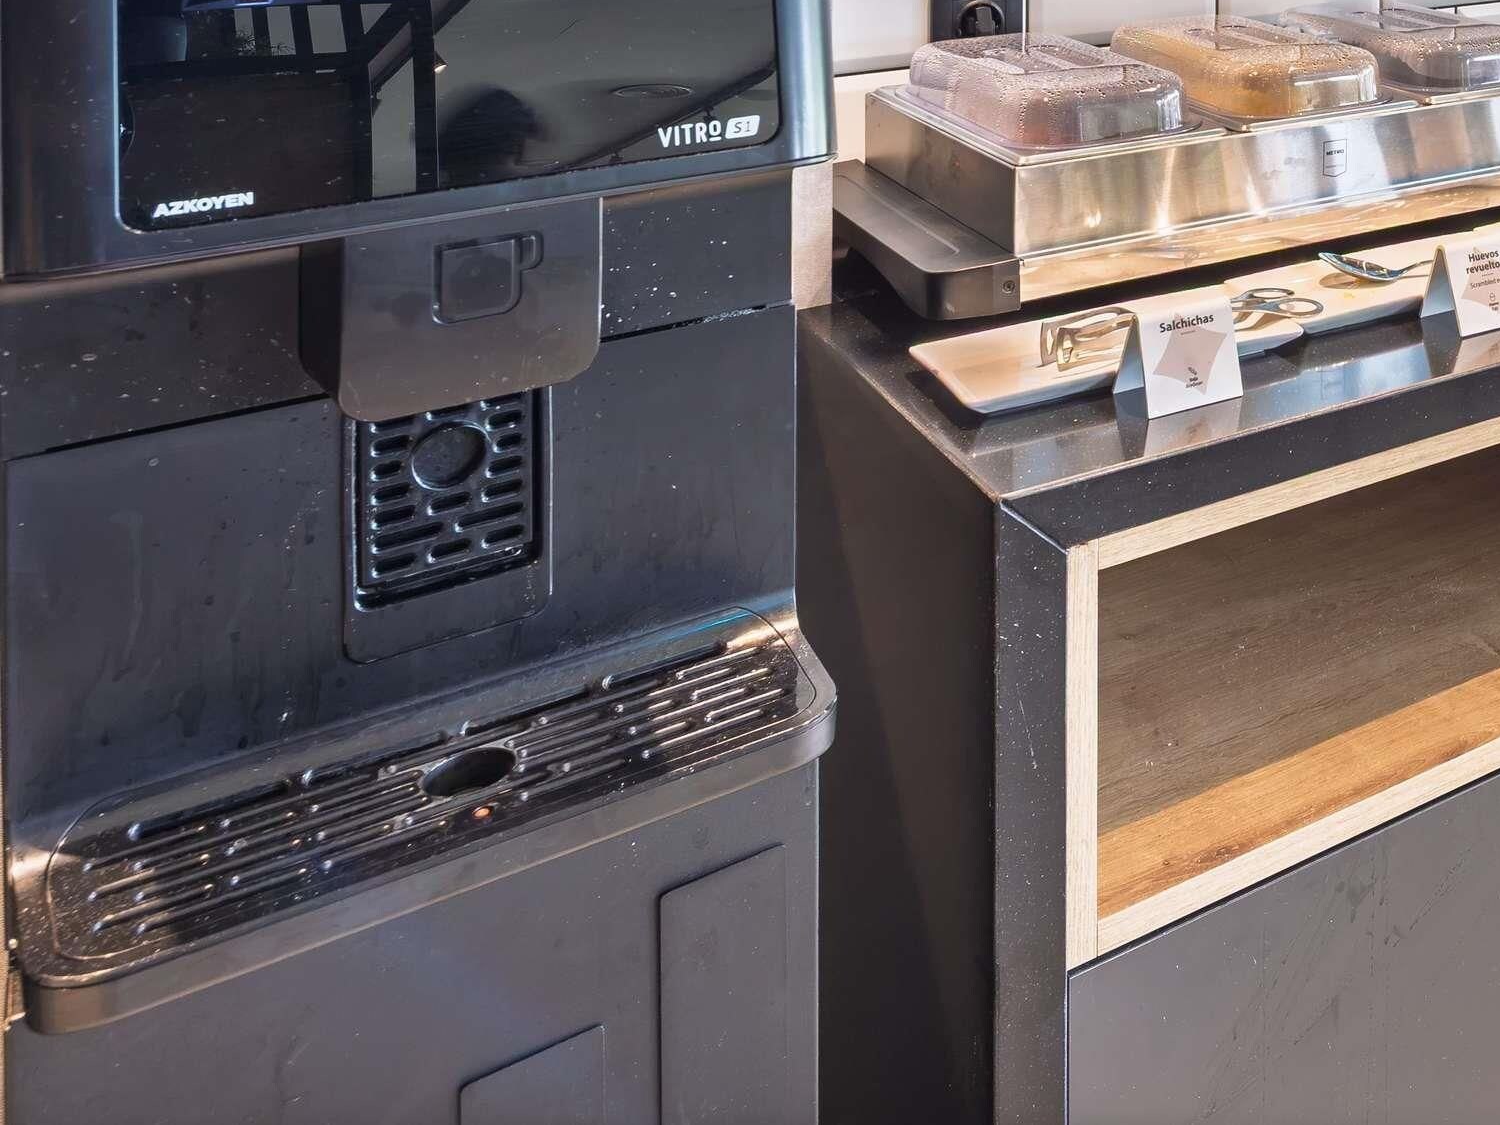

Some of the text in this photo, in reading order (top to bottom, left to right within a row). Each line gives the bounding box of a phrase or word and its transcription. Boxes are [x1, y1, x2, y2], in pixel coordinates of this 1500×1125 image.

[657, 120, 722, 148] VITRO
[153, 191, 254, 218] AZKOYEN
[1468, 250, 1500, 263] Huevos
[1470, 278, 1497, 289] Scrambled
[1159, 314, 1215, 334] Salchichas
